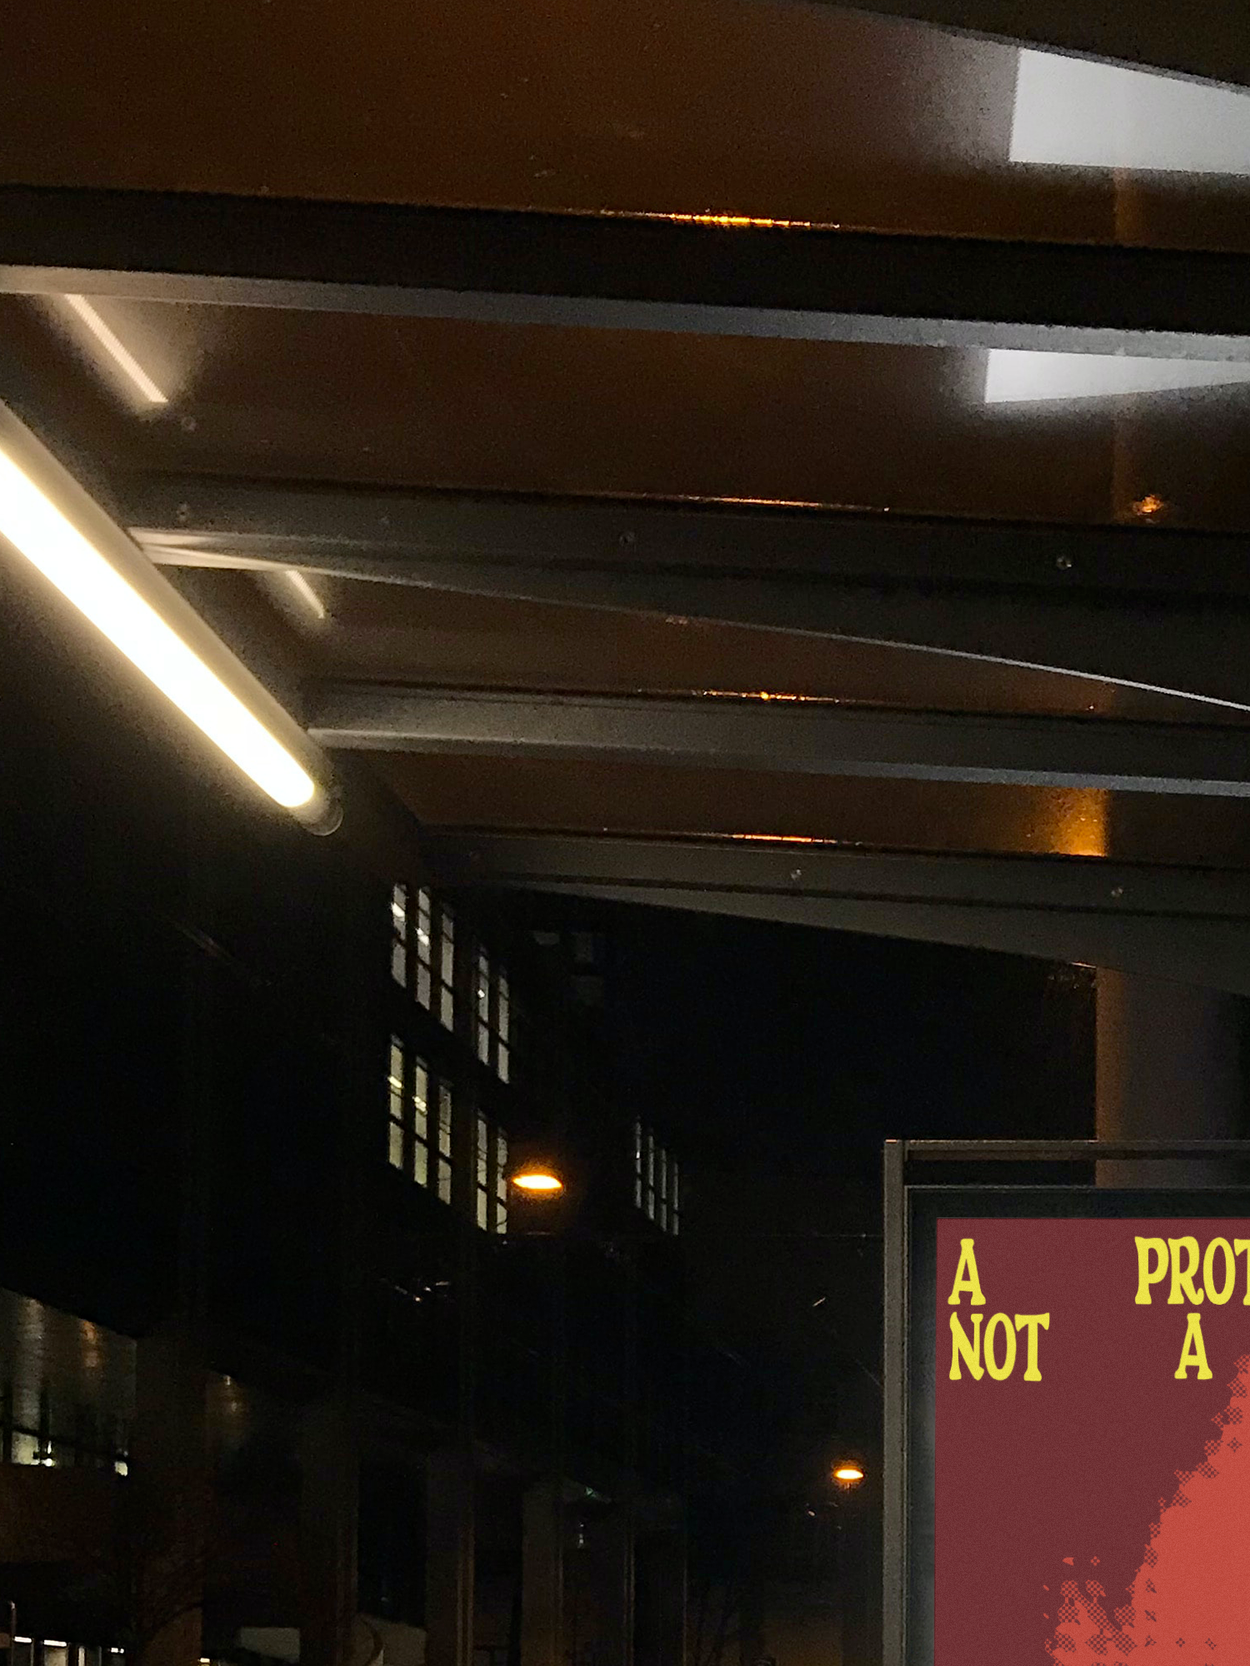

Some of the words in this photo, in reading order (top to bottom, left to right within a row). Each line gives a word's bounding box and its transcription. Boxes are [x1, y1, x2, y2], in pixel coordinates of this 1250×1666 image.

[948, 1238, 986, 1305] A
[949, 1311, 1050, 1381] NOT
[1174, 1313, 1213, 1380] A
